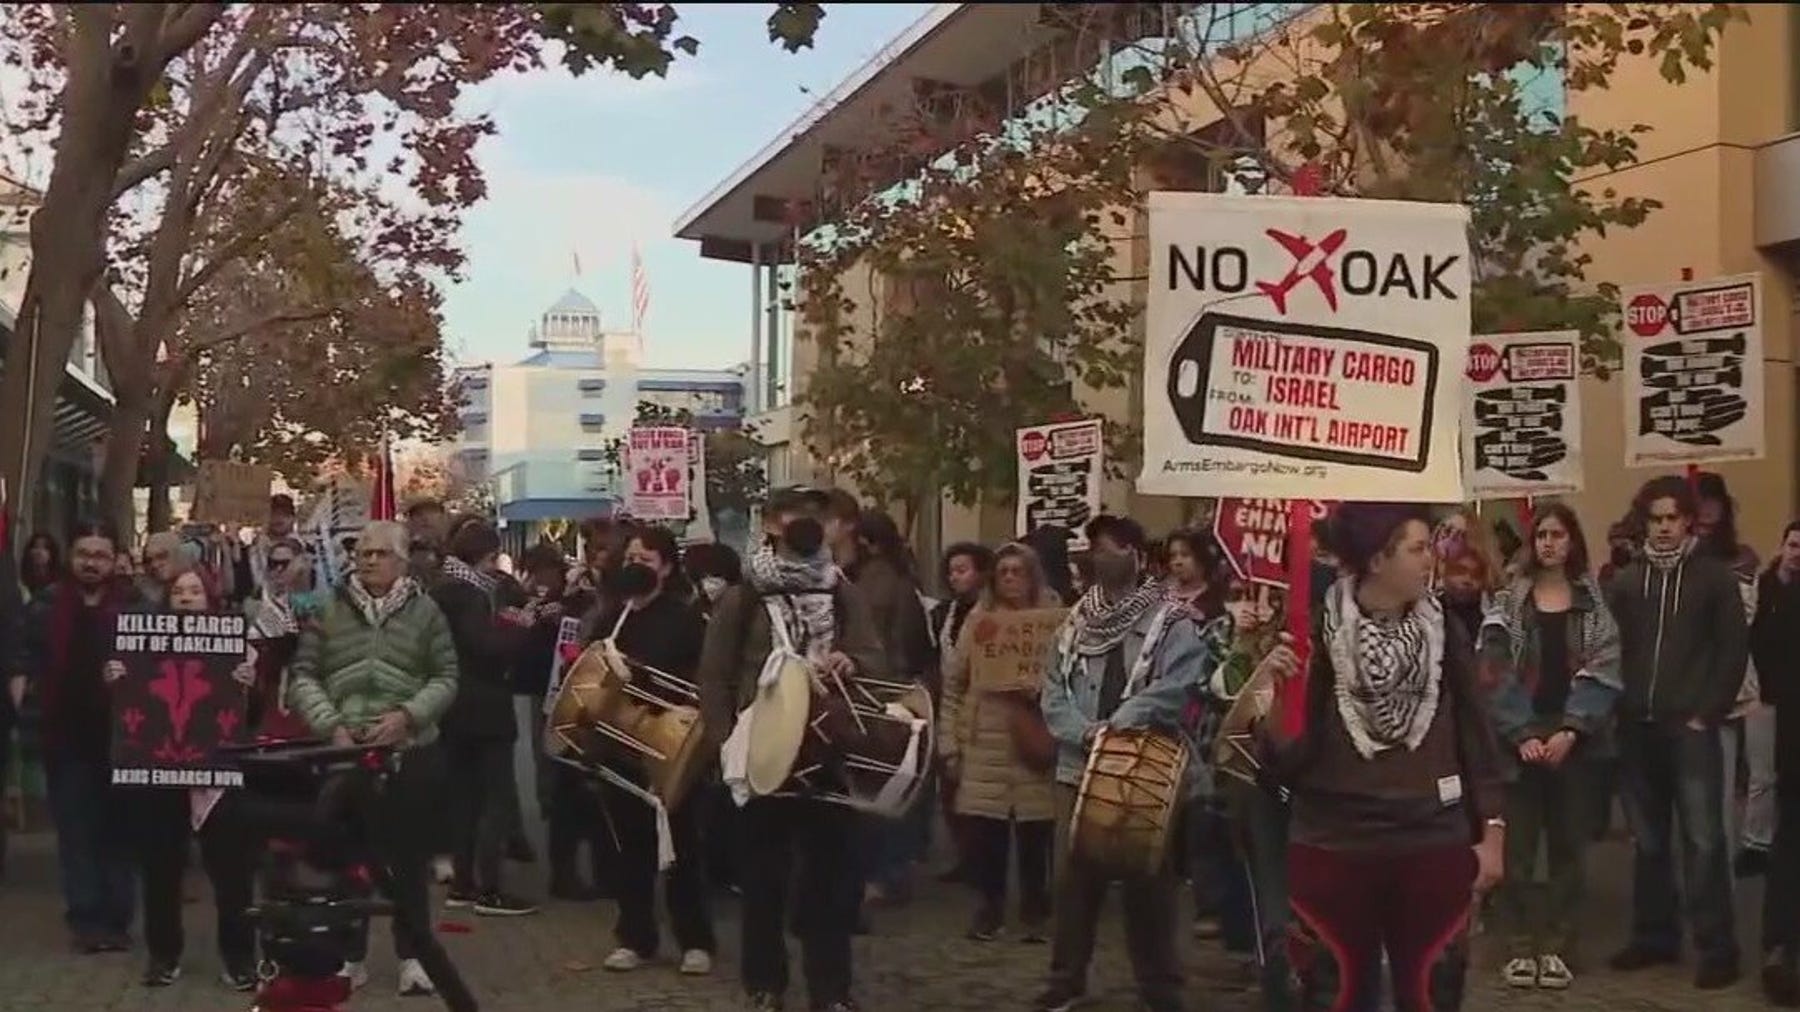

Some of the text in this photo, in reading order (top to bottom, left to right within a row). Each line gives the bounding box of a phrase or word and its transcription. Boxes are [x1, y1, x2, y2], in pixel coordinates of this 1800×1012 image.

[1168, 244, 1459, 300] NO OAK
[1628, 306, 1666, 326] STOP
[1232, 338, 1416, 386] MILITARY CARGO
[1265, 375, 1341, 410] ISRAEL
[1229, 406, 1409, 454] OAK INT'L AIRPORT
[1163, 458, 1328, 479] ArmsEmbargoNow.org
[1241, 532, 1284, 564] NO
[116, 614, 245, 637] KILLER CARGO
[115, 635, 245, 654] OUT OF OAKLAND
[112, 769, 245, 787] ARMS EMBARGO NOW
